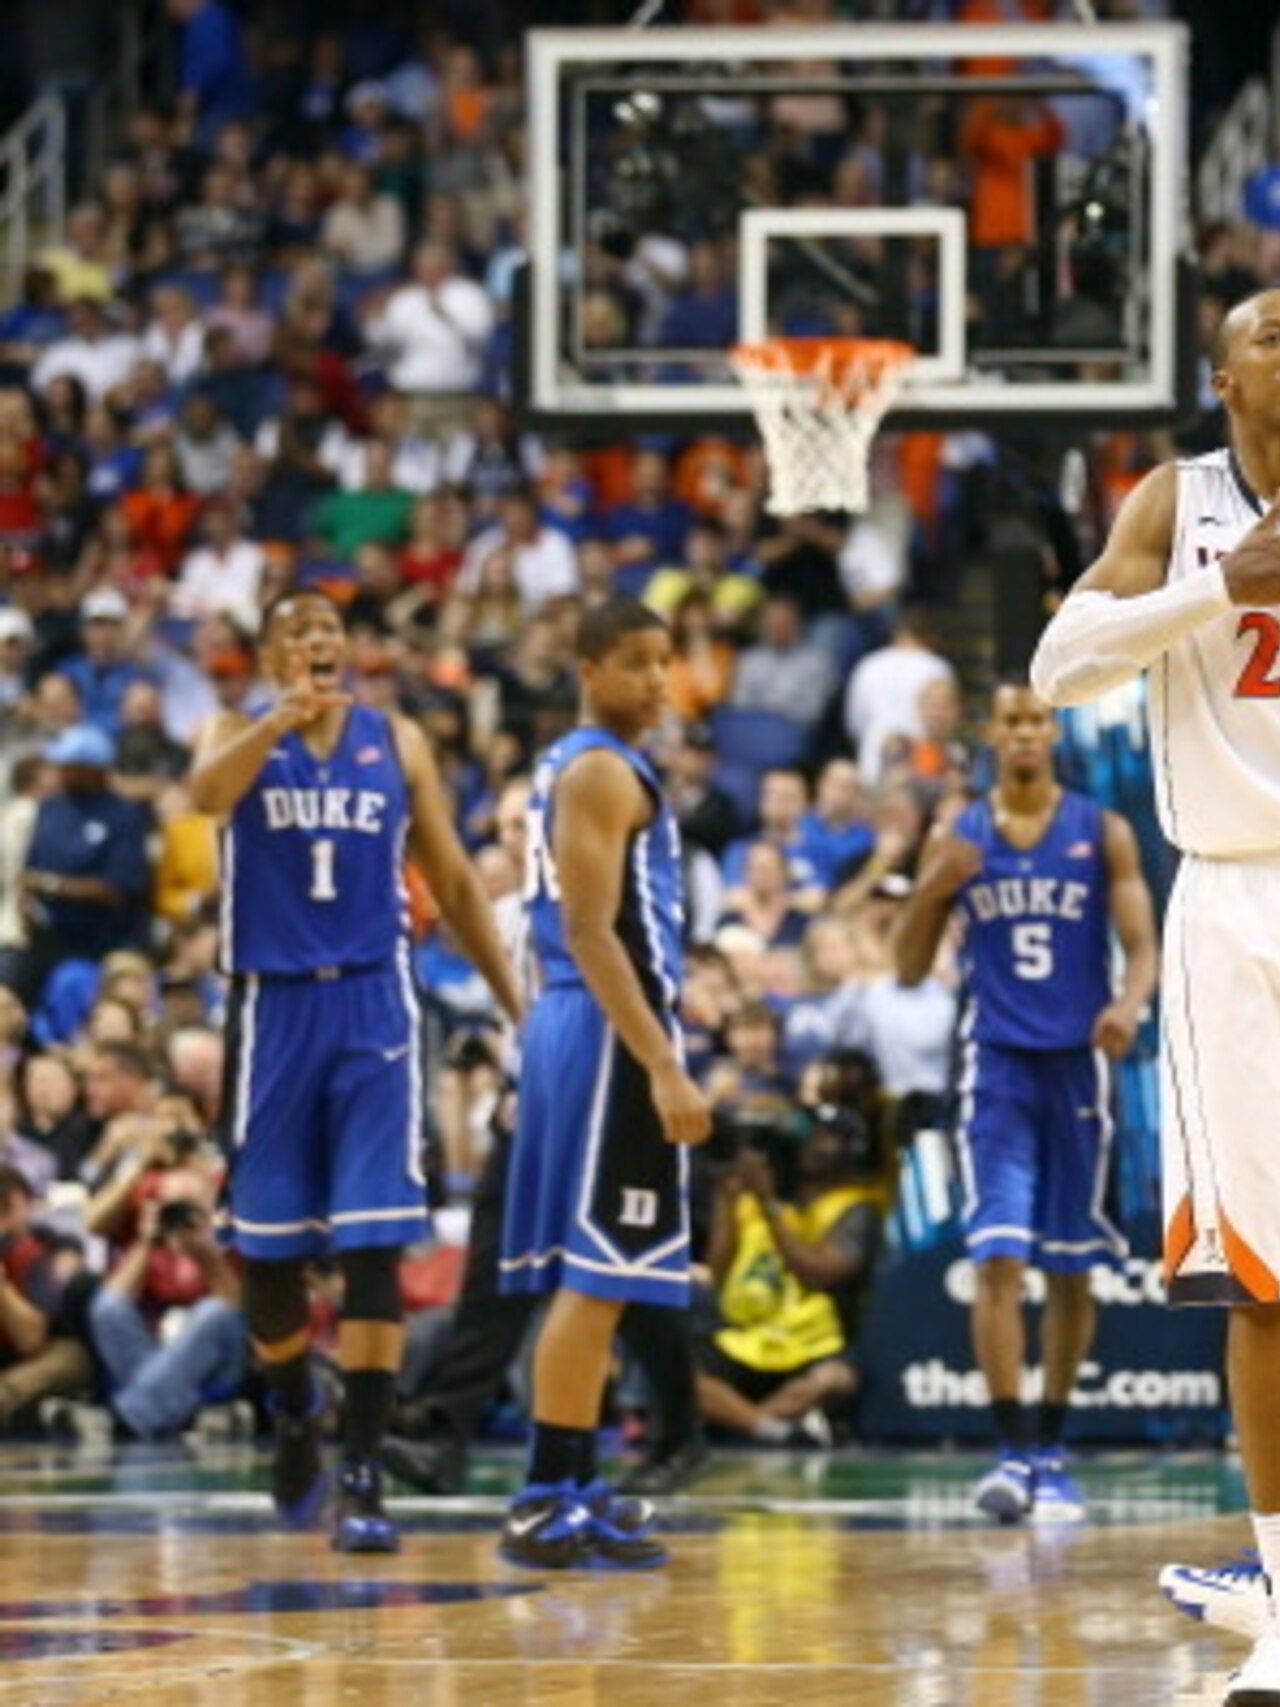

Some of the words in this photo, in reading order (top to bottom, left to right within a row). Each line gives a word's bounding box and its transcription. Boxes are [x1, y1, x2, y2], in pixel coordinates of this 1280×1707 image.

[263, 787, 386, 834] DUKE
[309, 839, 338, 900] 1
[970, 877, 1088, 922] DUKE
[1011, 922, 1053, 981] 5
[619, 1188, 658, 1226] D
